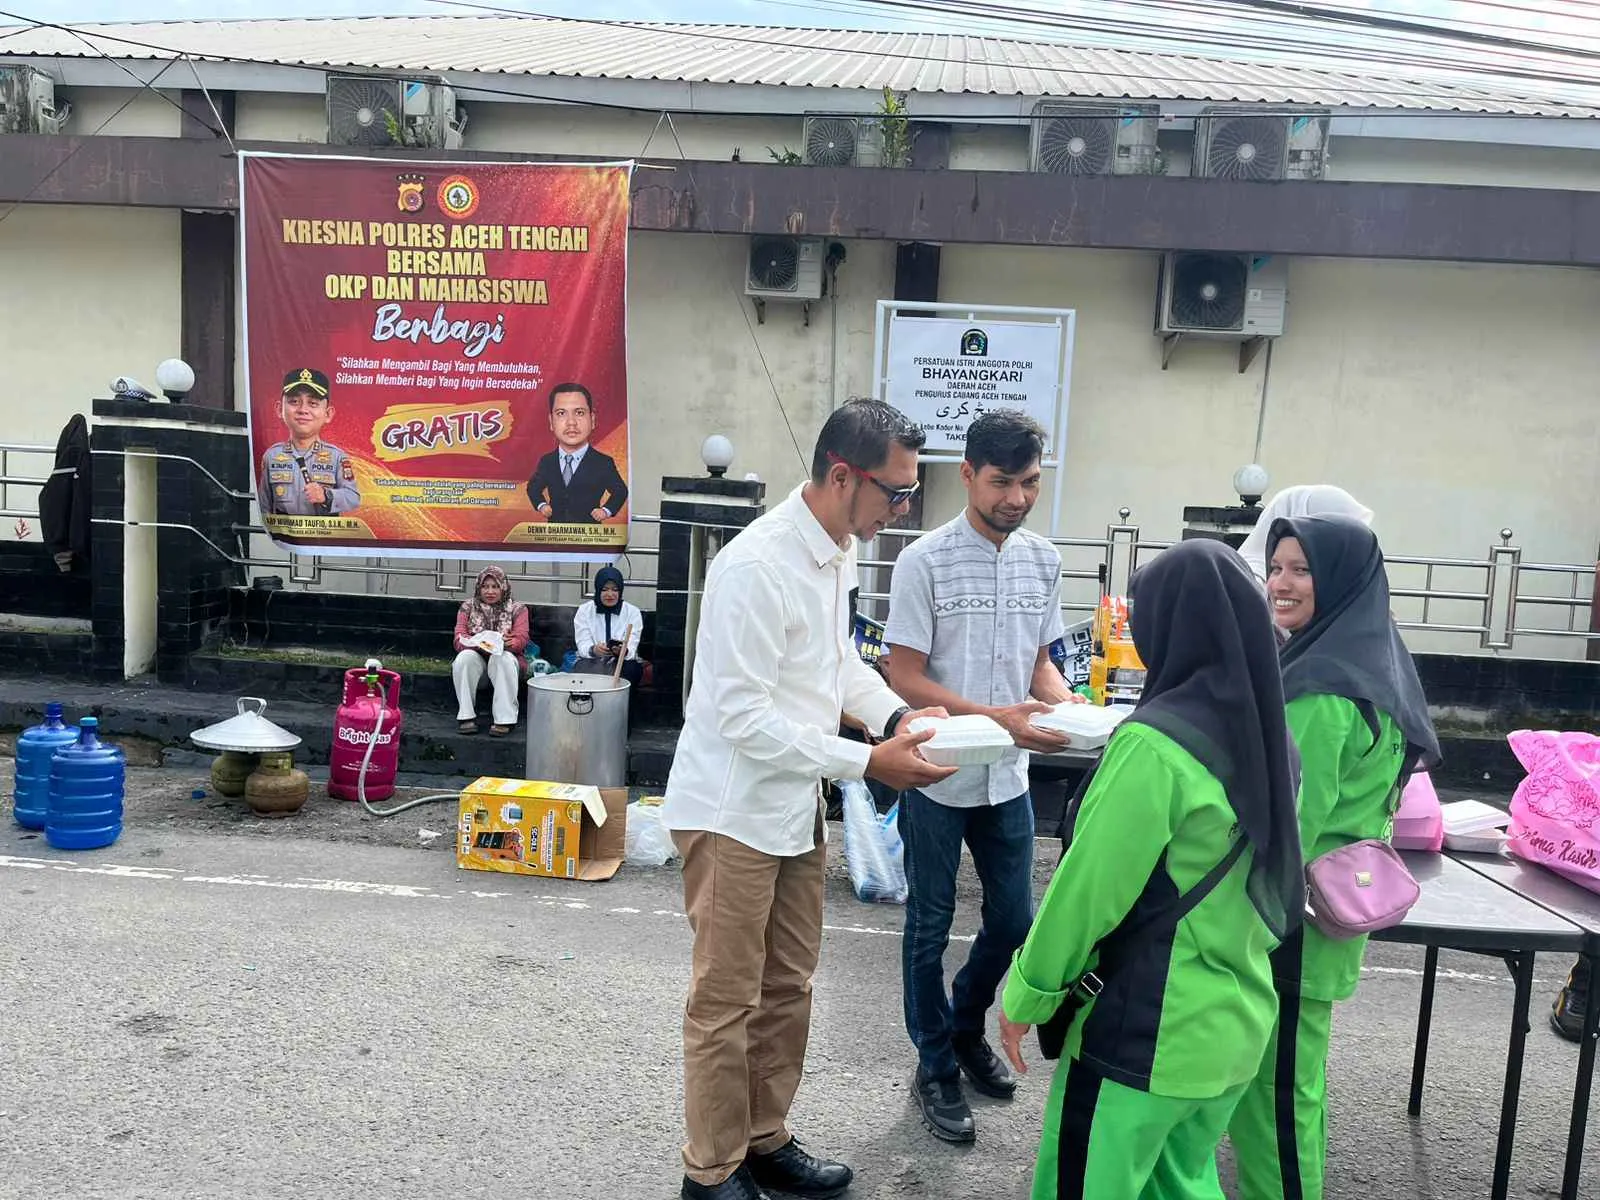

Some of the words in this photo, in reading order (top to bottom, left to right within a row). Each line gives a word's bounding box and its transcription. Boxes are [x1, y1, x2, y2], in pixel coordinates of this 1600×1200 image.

[282, 219, 365, 246] KRESNA
[369, 221, 446, 249] POLRES
[450, 224, 504, 250] ACEH
[508, 225, 588, 252] TENGAH
[387, 249, 486, 276] BERSAMA
[325, 274, 367, 299] OKP
[372, 275, 414, 301] DAN
[418, 277, 549, 305] MAHASISWA
[372, 303, 505, 357] Berbagi
[382, 358, 430, 372] Mengambil
[432, 360, 452, 373] Bagi
[455, 361, 475, 374] Yang
[477, 361, 541, 375] Membutuhkan,
[913, 357, 955, 366] PERSATUAN
[957, 359, 975, 367] ISTRI
[977, 360, 1009, 368] ANGGOTA
[1012, 361, 1033, 369] POLRI
[336, 373, 373, 385] Silahkan
[376, 374, 414, 386] Memberi
[417, 375, 436, 388] Bagi
[438, 376, 459, 389] Yang
[461, 377, 483, 390] Ingin
[922, 368, 1023, 382] BHAYANGKARI
[947, 382, 976, 390] DAERAH
[977, 383, 996, 391] ACEH
[915, 390, 951, 399] PENGURUS
[953, 391, 980, 399] CABANG
[981, 392, 999, 400] ACEH
[1001, 393, 1027, 401] TENGAH
[381, 409, 504, 452] GRATIS
[312, 463, 334, 471] POLRI
[527, 526, 546, 534] DENNY
[1558, 840, 1598, 869] Kasih
